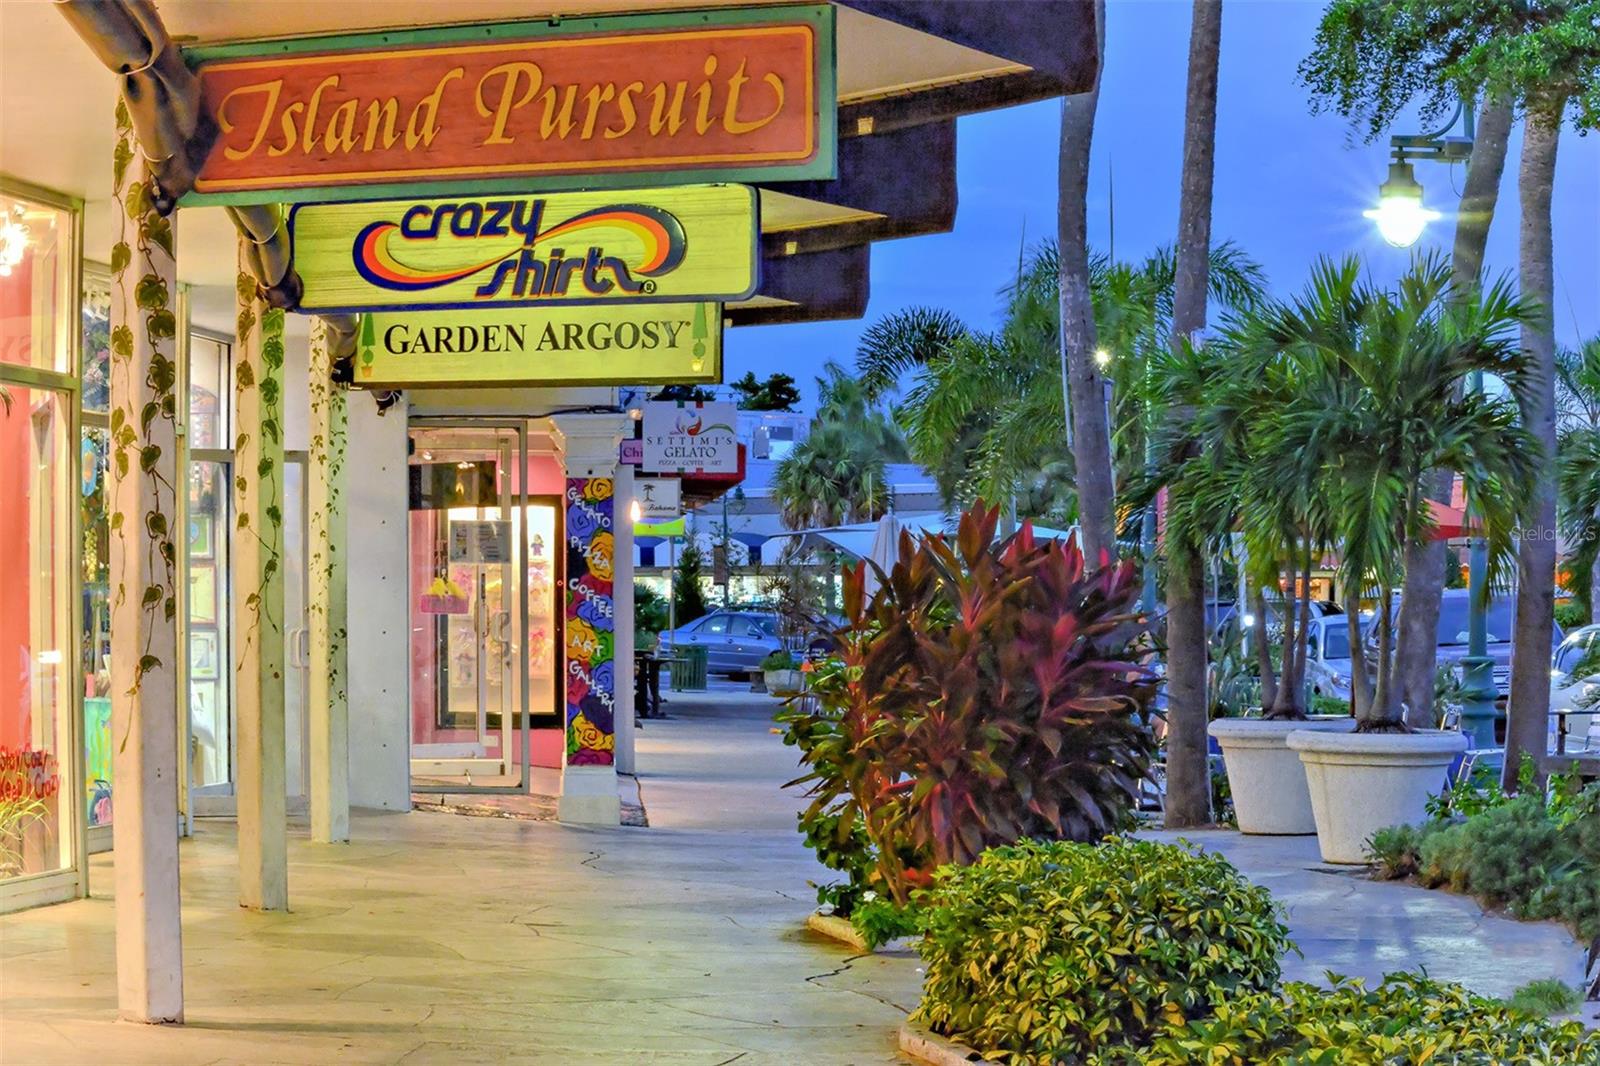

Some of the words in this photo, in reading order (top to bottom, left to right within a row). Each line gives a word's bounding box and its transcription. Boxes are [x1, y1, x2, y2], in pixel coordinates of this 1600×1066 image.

[217, 67, 465, 161] Island
[475, 54, 785, 146] Pursuit
[400, 200, 546, 247] crazy
[475, 246, 644, 299] shirts
[384, 323, 526, 355] GARDEN
[536, 320, 684, 353] ARGOSY
[622, 447, 643, 458] Chi
[646, 436, 733, 446] SETTIMI'S
[663, 446, 717, 459] GELATO
[566, 486, 612, 528] GELATO
[570, 535, 611, 569] PIZZA
[568, 577, 613, 618] COFFEE
[572, 634, 605, 658] ART
[569, 660, 615, 713] GALLERY
